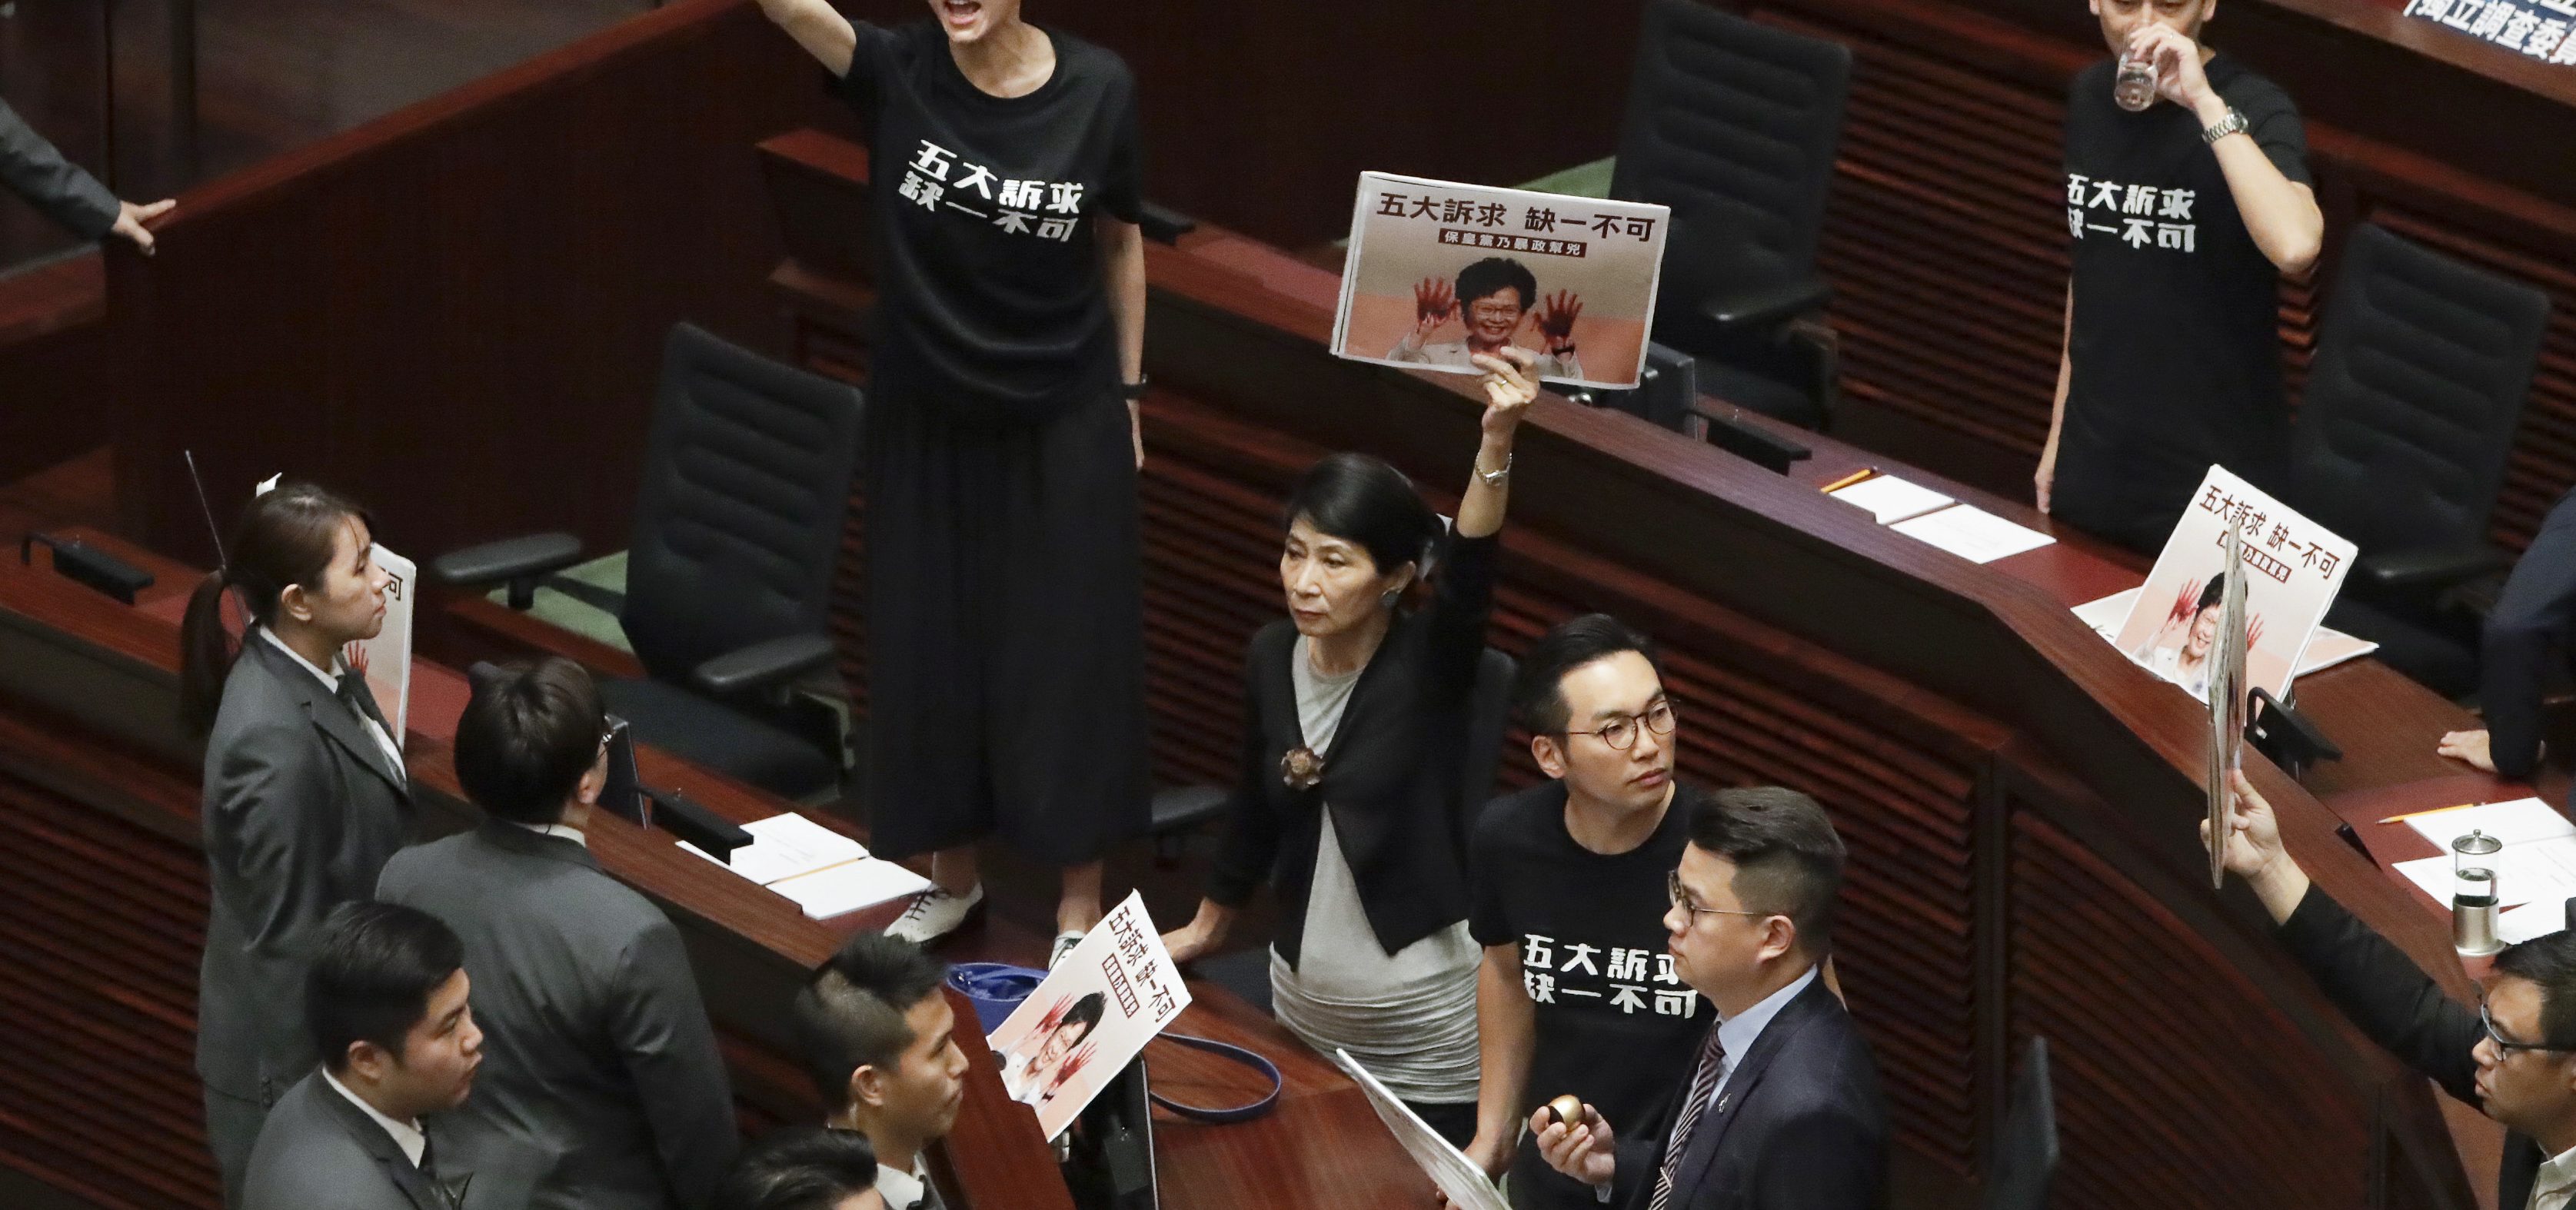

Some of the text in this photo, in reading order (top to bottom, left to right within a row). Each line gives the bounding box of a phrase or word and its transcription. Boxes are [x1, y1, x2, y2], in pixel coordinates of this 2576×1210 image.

[898, 171, 1078, 242] 缺一不可
[909, 139, 1083, 214] 五大訴求
[2068, 173, 2195, 221] 五大訴求
[1376, 192, 1656, 242] 五大訴求 缺一不可
[2199, 484, 2267, 537] 五大訴求
[2267, 522, 2341, 580] 缺一不可
[1108, 906, 1149, 967] 五大訴求
[1135, 958, 1177, 1023] 缺一不可
[1523, 969, 1698, 1019] 缺一不可
